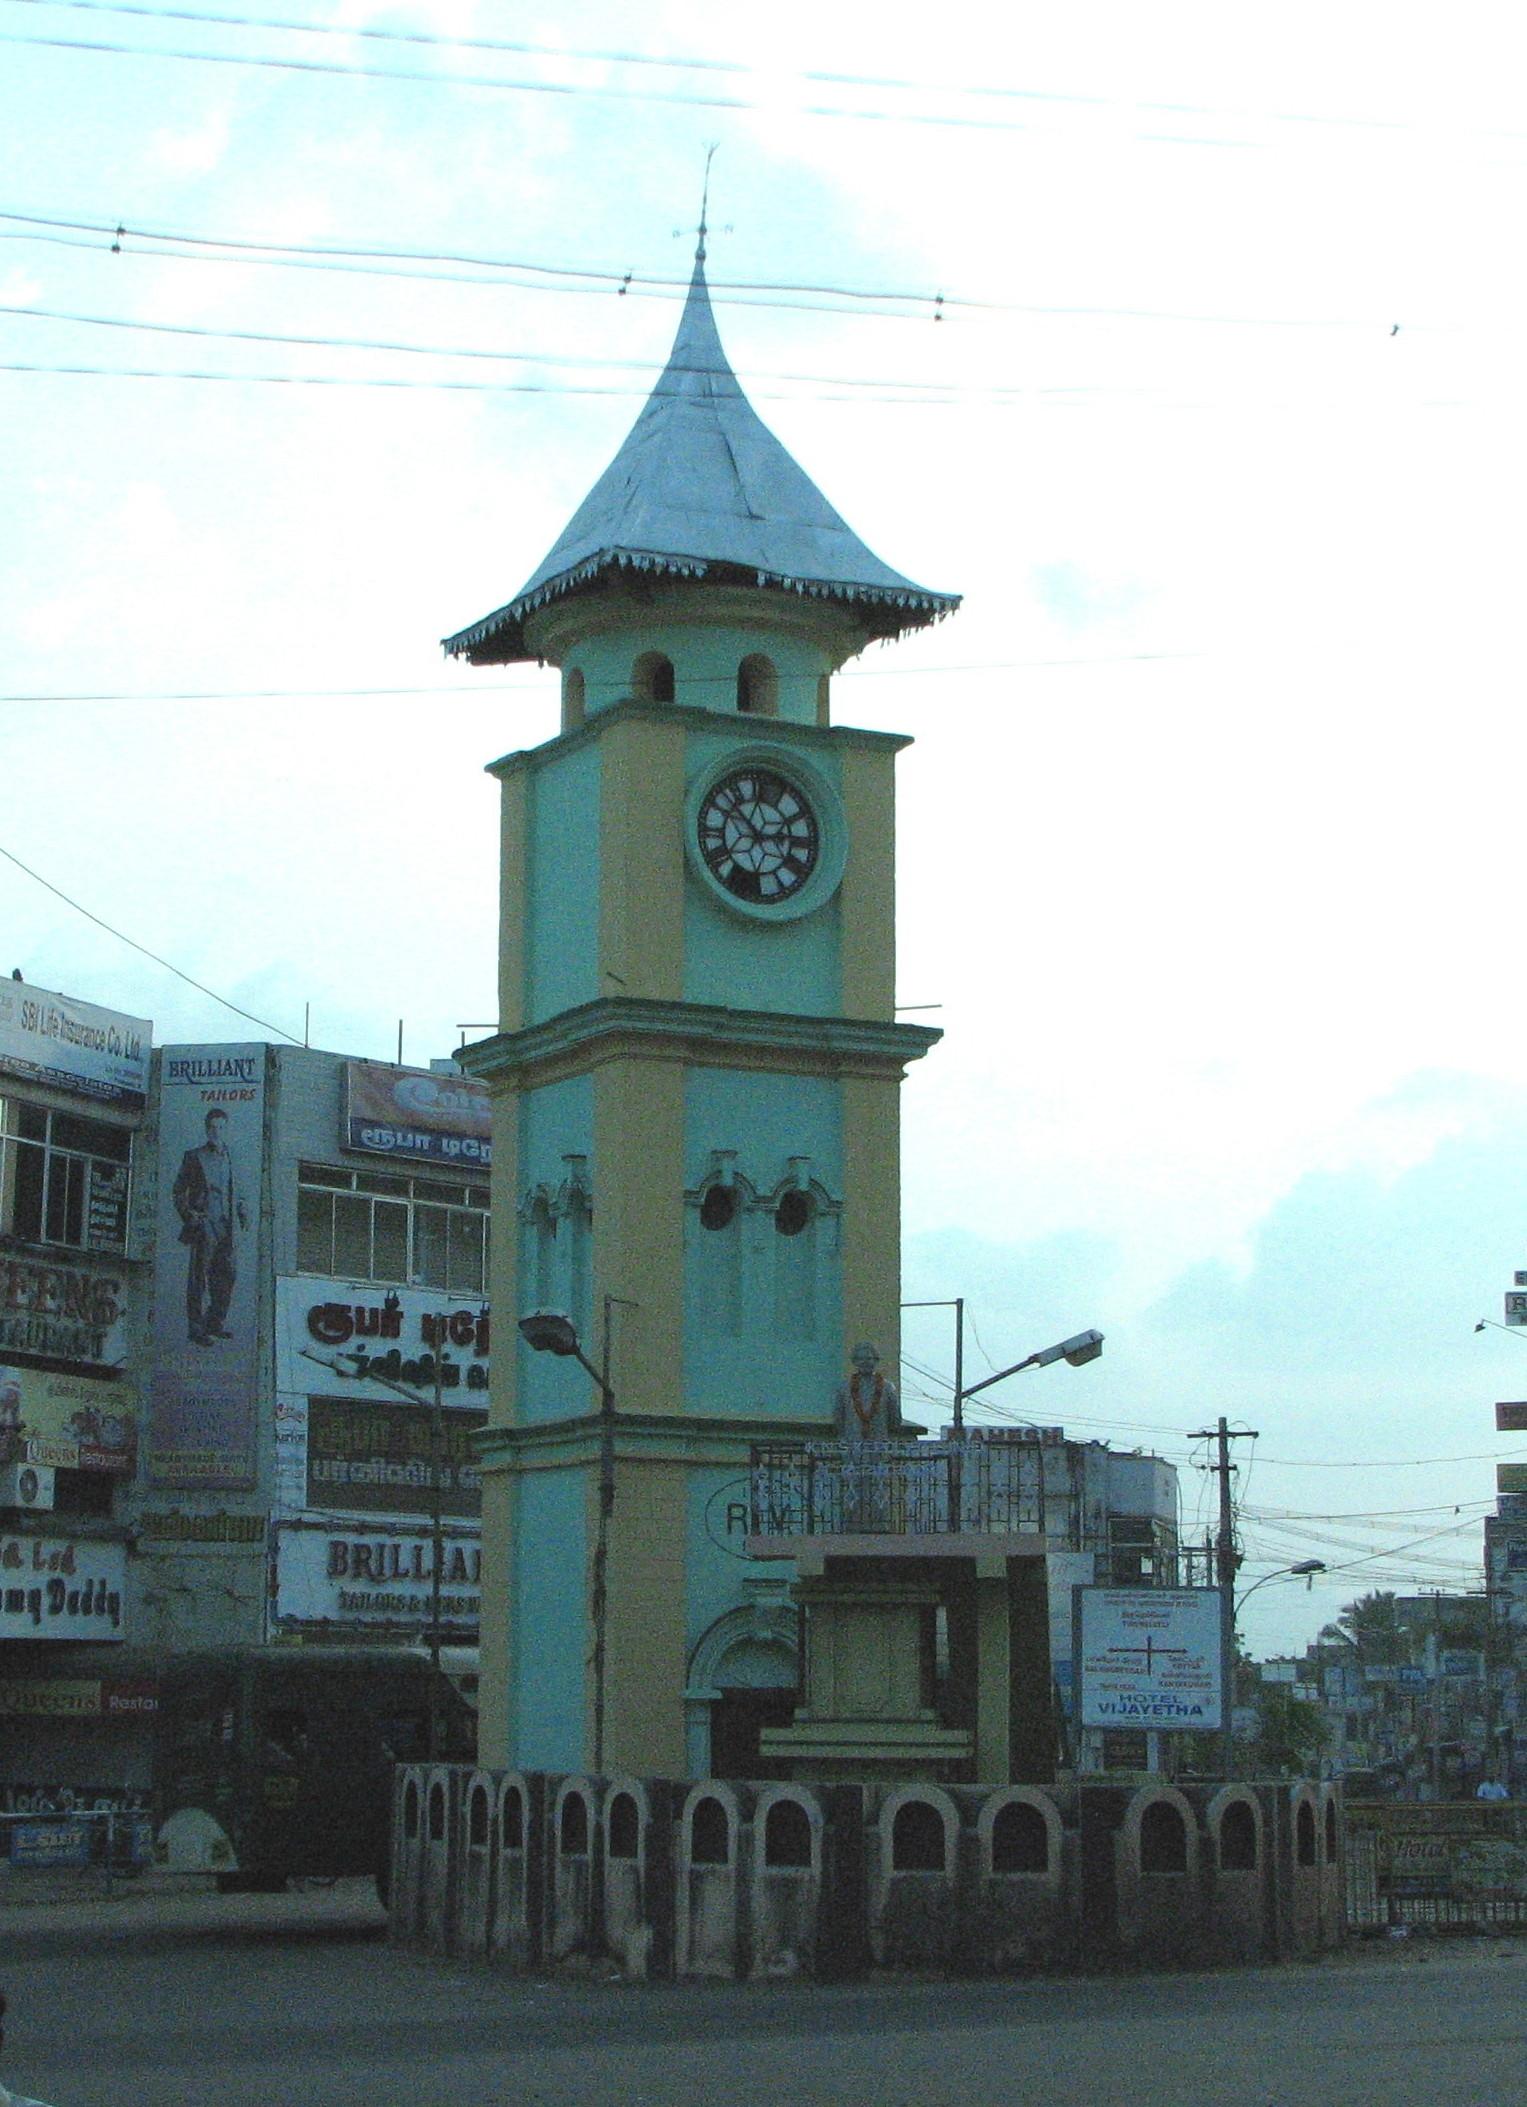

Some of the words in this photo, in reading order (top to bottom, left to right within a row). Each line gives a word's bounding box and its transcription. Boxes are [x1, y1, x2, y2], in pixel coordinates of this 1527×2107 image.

[21, 1000, 38, 1032] SBI
[60, 1011, 106, 1053] Insurance
[168, 1057, 259, 1084] BRILLIANT
[200, 1088, 256, 1102] TAILORS
[327, 1540, 481, 1583] BRILLA
[0, 1587, 42, 1626] my
[47, 1578, 120, 1628] Daddy
[1097, 1702, 1203, 1716] VIJAYETHA
[1119, 1694, 1183, 1704] HOTEL
